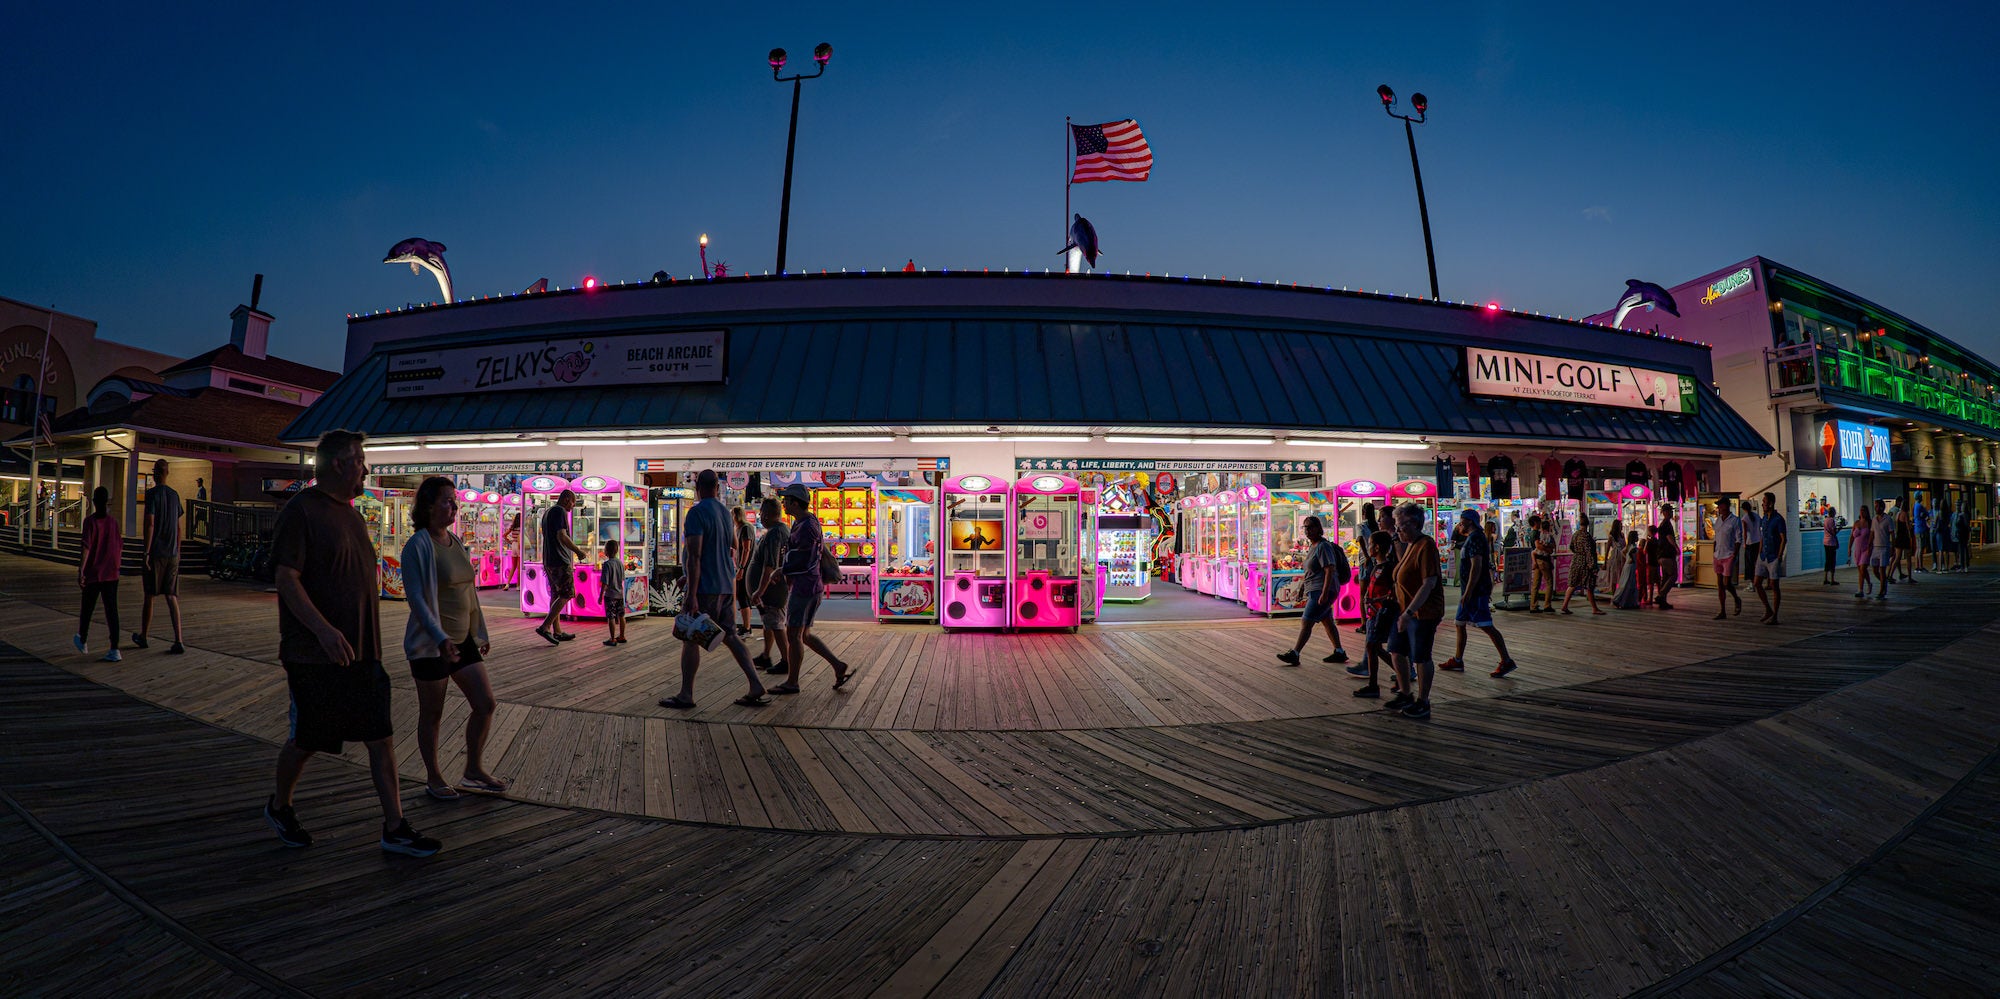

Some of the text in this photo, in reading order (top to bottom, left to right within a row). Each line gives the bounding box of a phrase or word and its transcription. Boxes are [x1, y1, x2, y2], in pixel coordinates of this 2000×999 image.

[627, 345, 712, 361] BEACH ARCADE
[0, 342, 58, 384] FUNLAND
[648, 362, 689, 372] SOUTH
[1475, 353, 1622, 392] MINI-GOLF
[1521, 387, 1546, 395] ZELKY'S
[1547, 389, 1573, 397] ROOFTOP
[1574, 391, 1597, 400] TERRACE
[1838, 429, 1865, 460] KOHR
[1080, 461, 1101, 469] LIFE,
[1102, 461, 1136, 470] LIBERTY,
[1137, 461, 1155, 469] AND
[1217, 462, 1265, 470] HAPPINESS!!!
